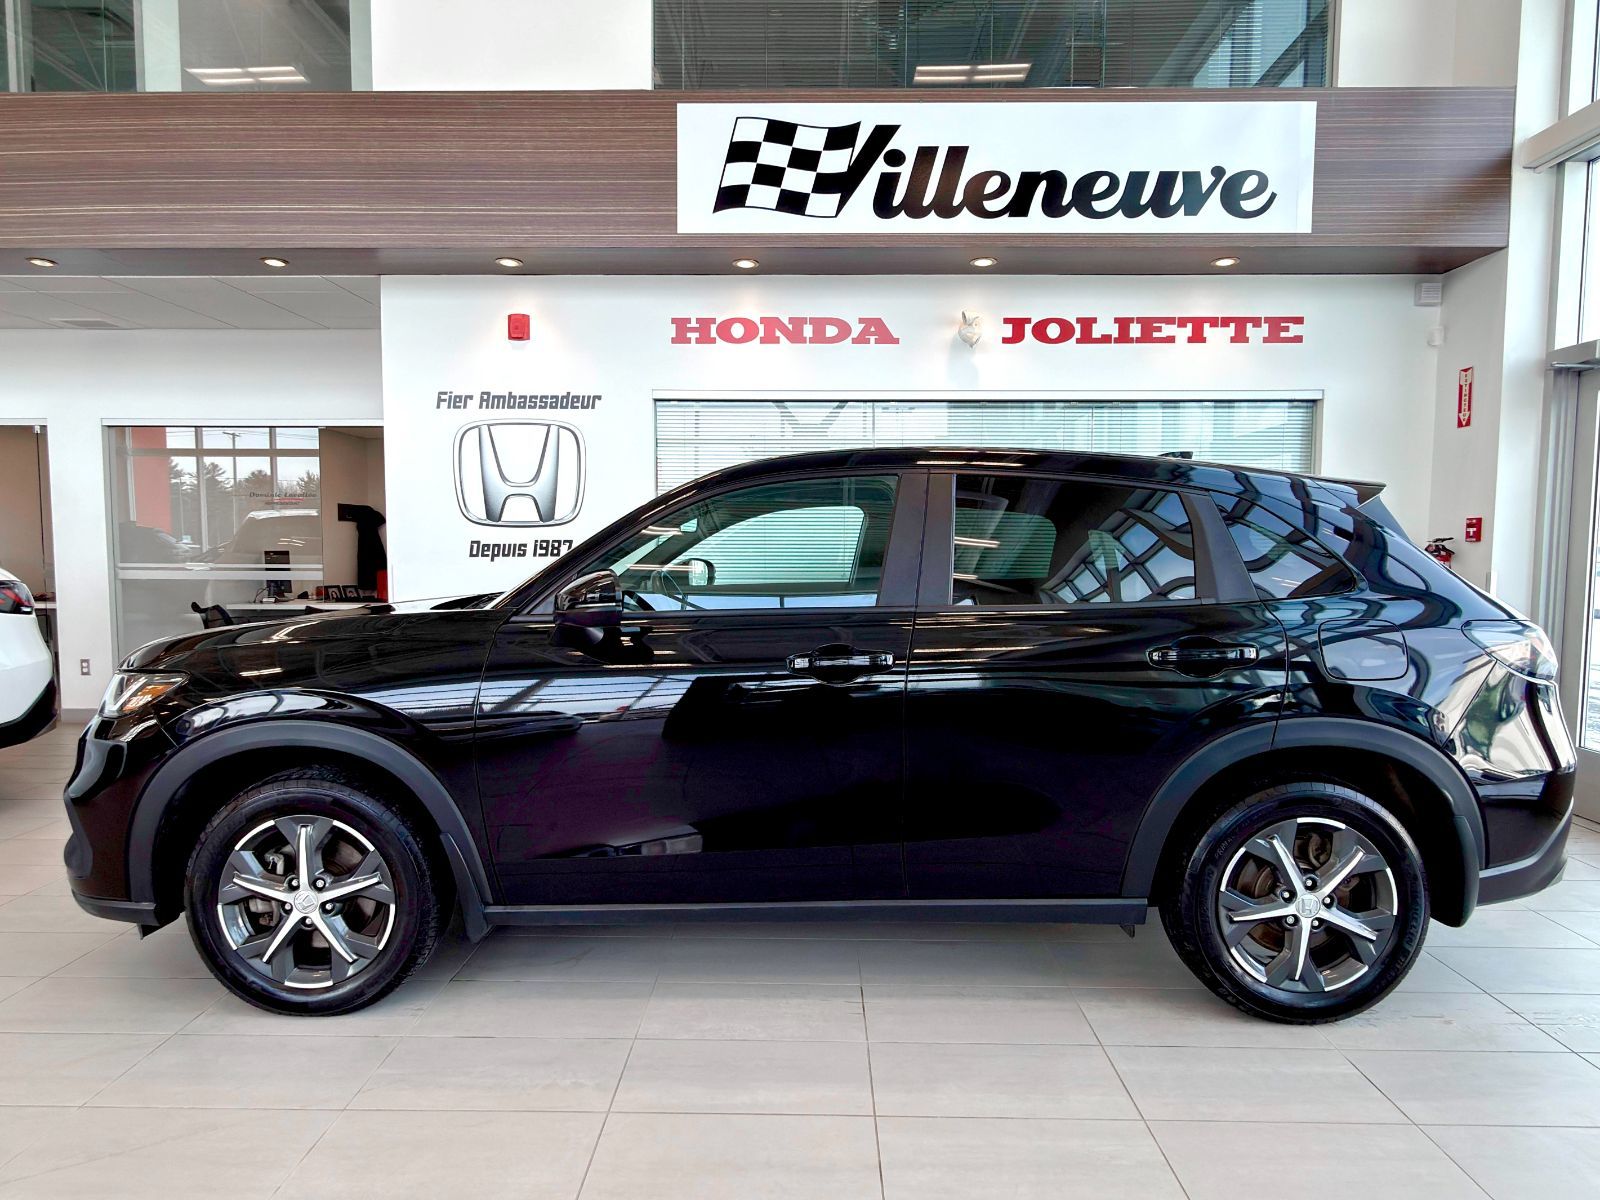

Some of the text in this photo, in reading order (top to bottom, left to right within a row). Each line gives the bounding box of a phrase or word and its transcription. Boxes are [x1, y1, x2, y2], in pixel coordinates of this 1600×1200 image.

[838, 122, 1277, 219] Villeneuve
[671, 316, 1304, 345] HONDA JOLIETTE
[436, 391, 602, 410] Fier Ambassadeur
[468, 539, 574, 562] Depuis 1987
